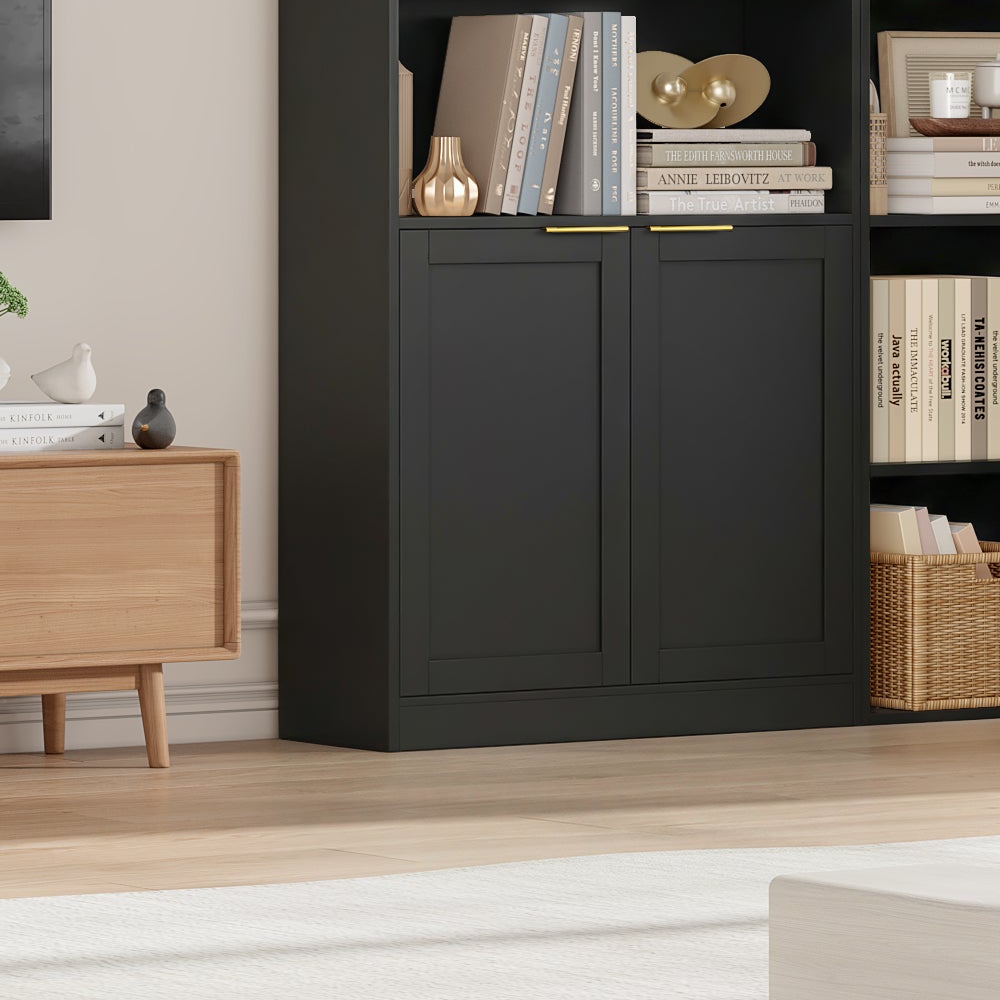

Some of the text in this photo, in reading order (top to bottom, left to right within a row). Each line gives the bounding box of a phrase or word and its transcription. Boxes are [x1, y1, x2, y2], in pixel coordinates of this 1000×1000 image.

[665, 150, 793, 161] THE EDITH FARNSWORTH HOUSE
[657, 173, 826, 185] ANNIE LEIBOVITZ AT WORK
[669, 197, 824, 212] The True Artist PHAIDON
[876, 333, 885, 408] the velvet underground
[889, 334, 903, 406] Java actually
[910, 328, 918, 413] THE IMMACULATE
[974, 317, 985, 421] TA-NEHISI COATES
[991, 363, 999, 405] underground
[9, 413, 53, 423] KINFOLK
[12, 435, 55, 445] KINFOLK
